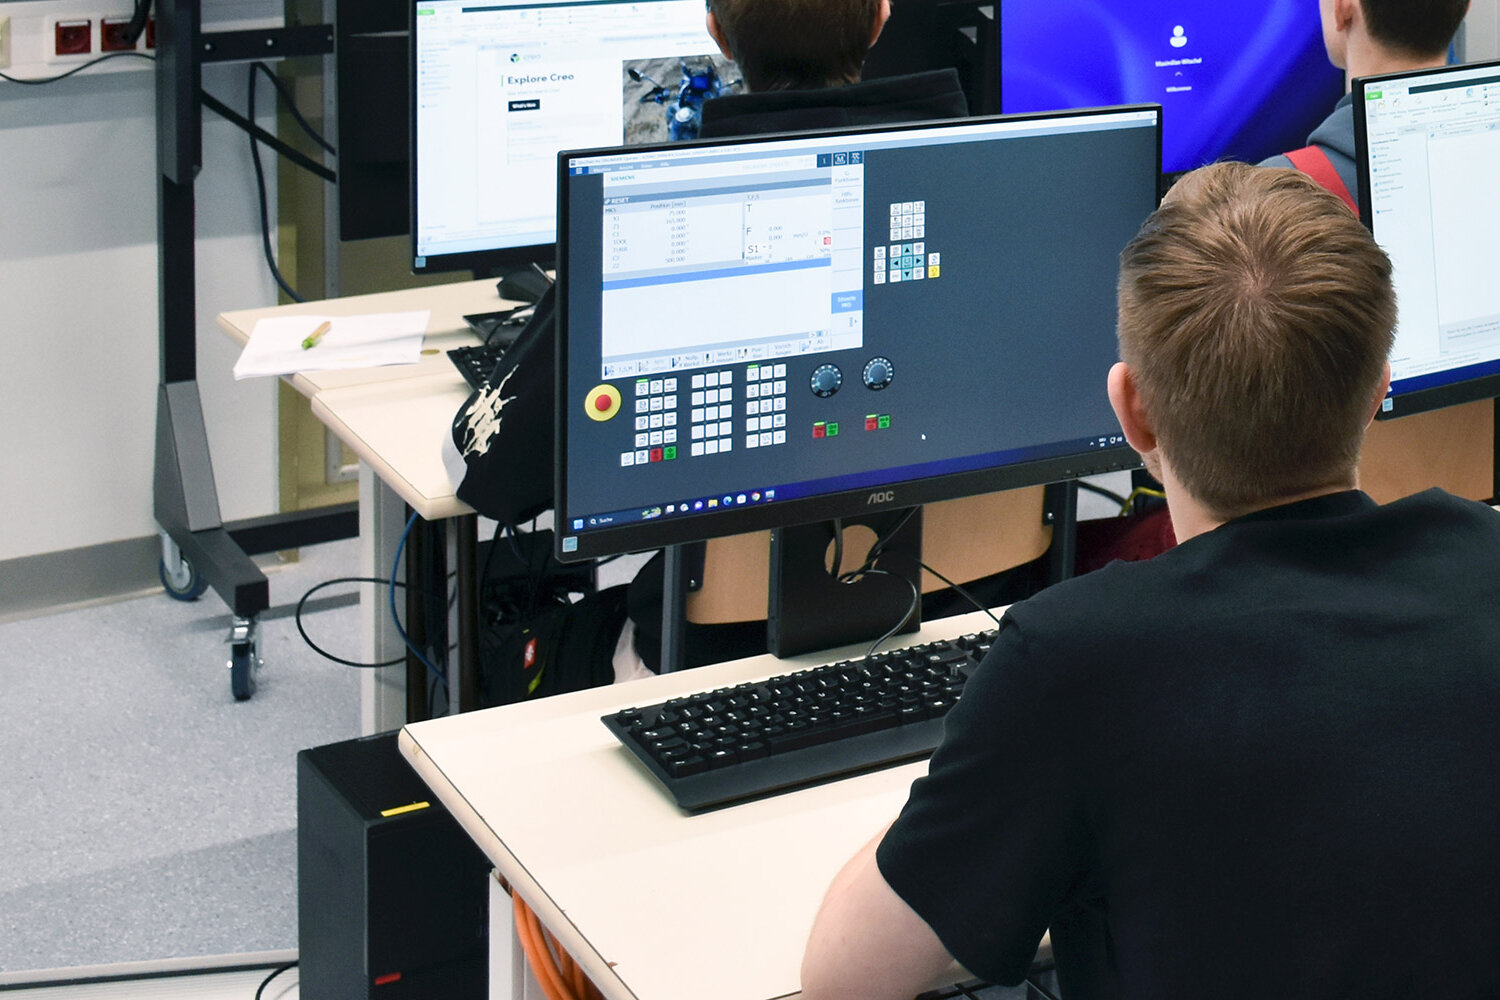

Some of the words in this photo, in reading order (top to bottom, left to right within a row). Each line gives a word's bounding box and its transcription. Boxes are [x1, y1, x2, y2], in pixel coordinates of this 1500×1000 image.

[507, 75, 547, 86] Explore
[550, 73, 575, 82] Creo
[746, 203, 753, 213] T
[746, 227, 752, 236] F
[747, 244, 759, 254] S1
[867, 490, 894, 504] AOC
